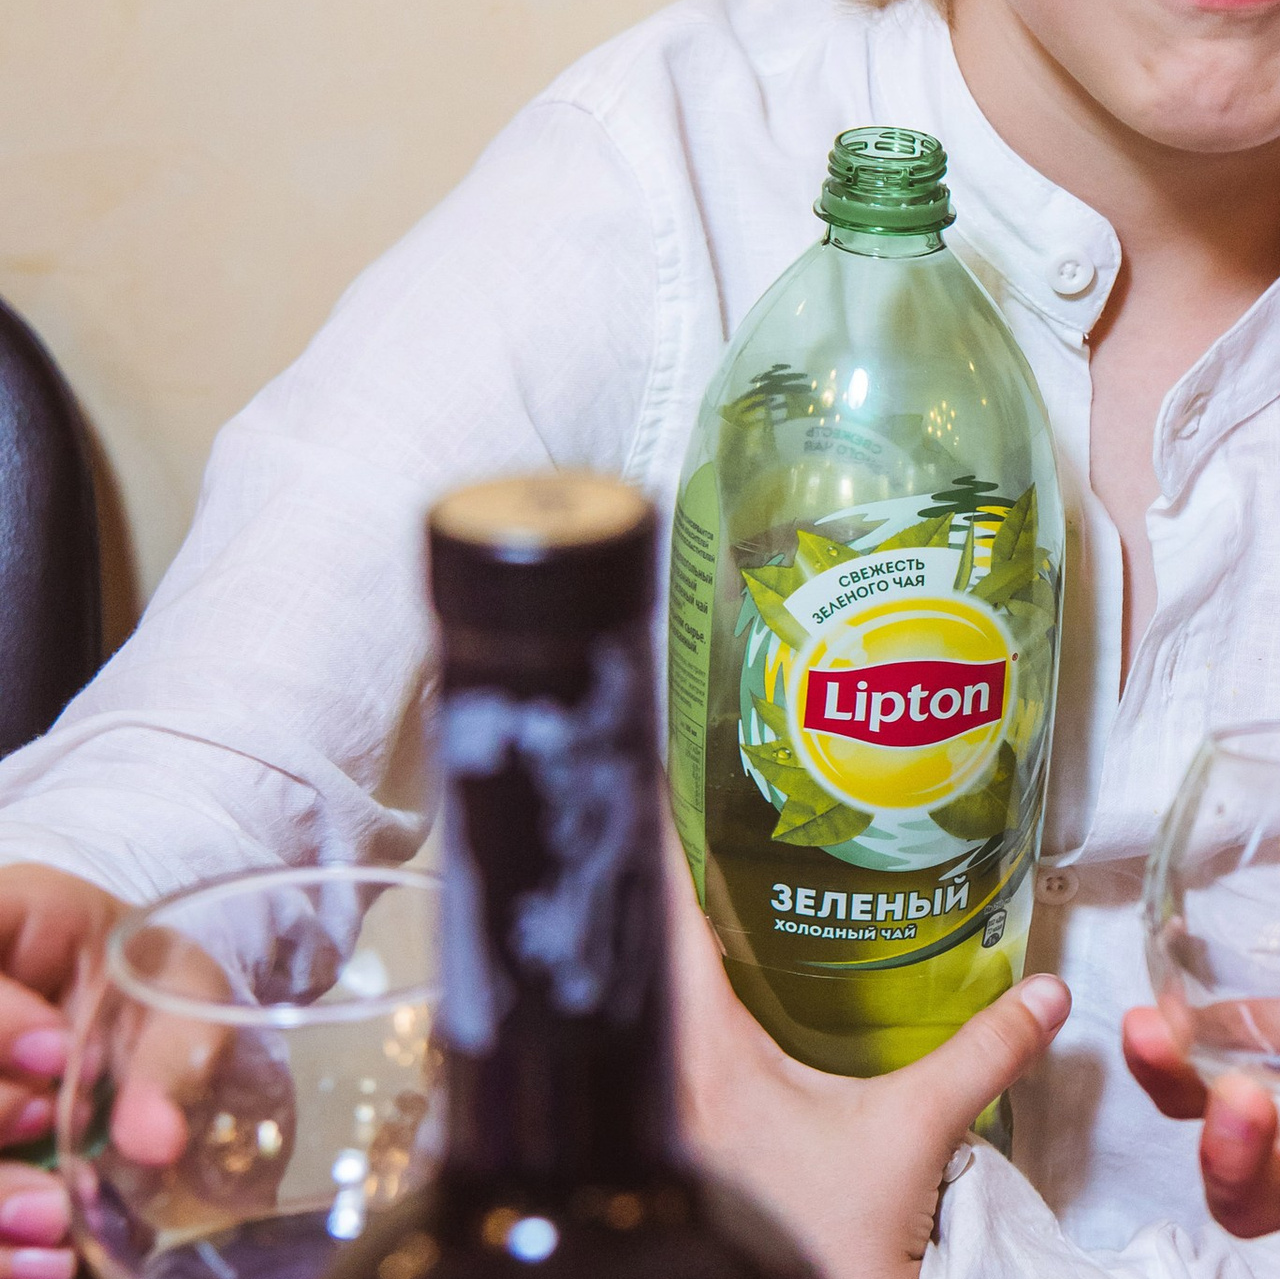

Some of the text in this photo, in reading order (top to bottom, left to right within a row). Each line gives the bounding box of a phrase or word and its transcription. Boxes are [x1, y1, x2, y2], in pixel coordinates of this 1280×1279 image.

[838, 558, 926, 588] СВЕЖЕСТЬ
[811, 574, 926, 625] ЗЕЛЕНОГО ЧАЯ
[823, 680, 991, 733] Lipton
[770, 874, 971, 922] ЗЕЛЕНЫЙ
[773, 918, 918, 941] ХОЛОДНЫЙ ЧАЙ
